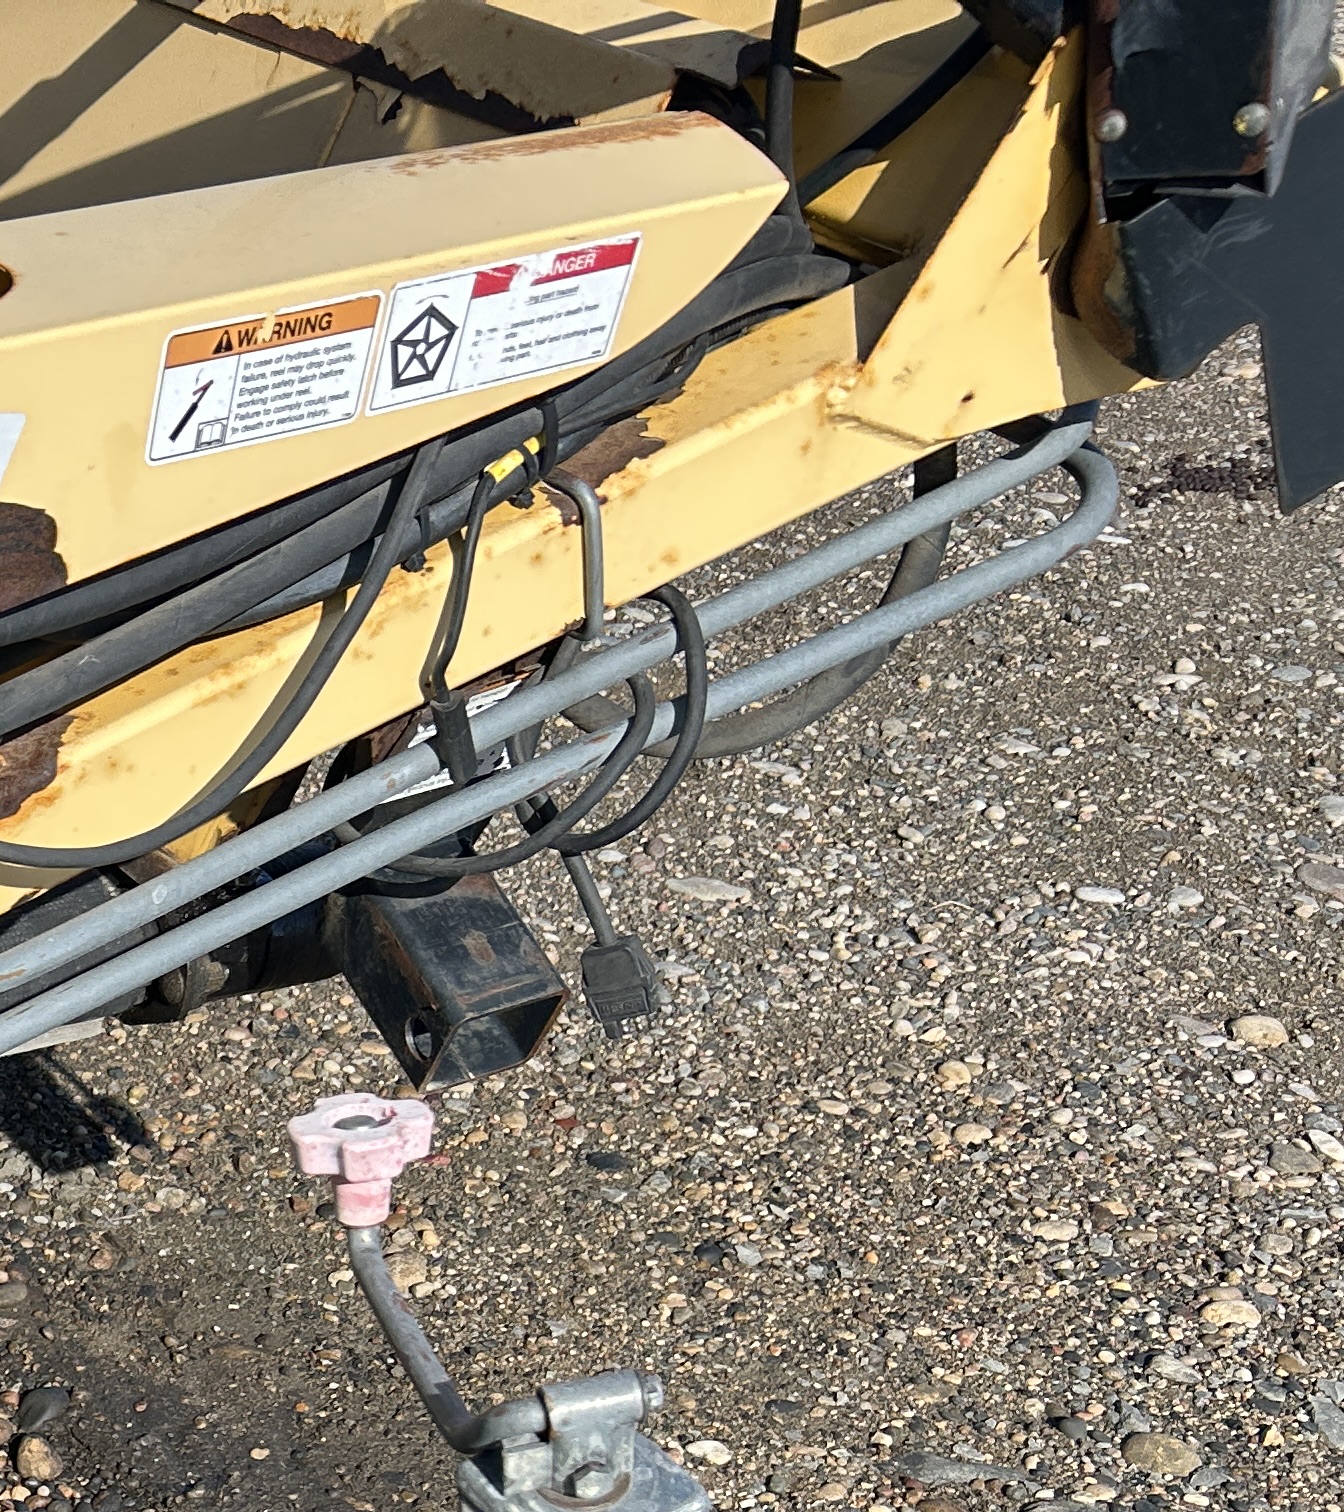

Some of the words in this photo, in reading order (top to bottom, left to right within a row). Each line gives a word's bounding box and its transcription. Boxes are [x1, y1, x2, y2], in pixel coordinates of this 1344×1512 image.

[548, 253, 597, 276] NGER
[238, 312, 333, 348] WRNING
[244, 362, 251, 370] In
[253, 358, 273, 368] case
[274, 354, 284, 364] of
[285, 347, 321, 362] hydraulic
[323, 342, 352, 355] system
[270, 367, 286, 377] reel
[287, 365, 305, 374] may
[306, 361, 325, 370] drop
[239, 385, 269, 396] Engage
[271, 379, 295, 389] safety
[297, 373, 317, 384] latch
[319, 369, 345, 379] before
[234, 411, 261, 421] Failure
[263, 408, 271, 416] to
[273, 401, 302, 413] comply
[304, 395, 326, 407] could
[327, 390, 350, 402] result
[237, 397, 268, 408] working
[270, 392, 294, 402] under
[241, 421, 264, 432] death
[276, 414, 305, 425] serious
